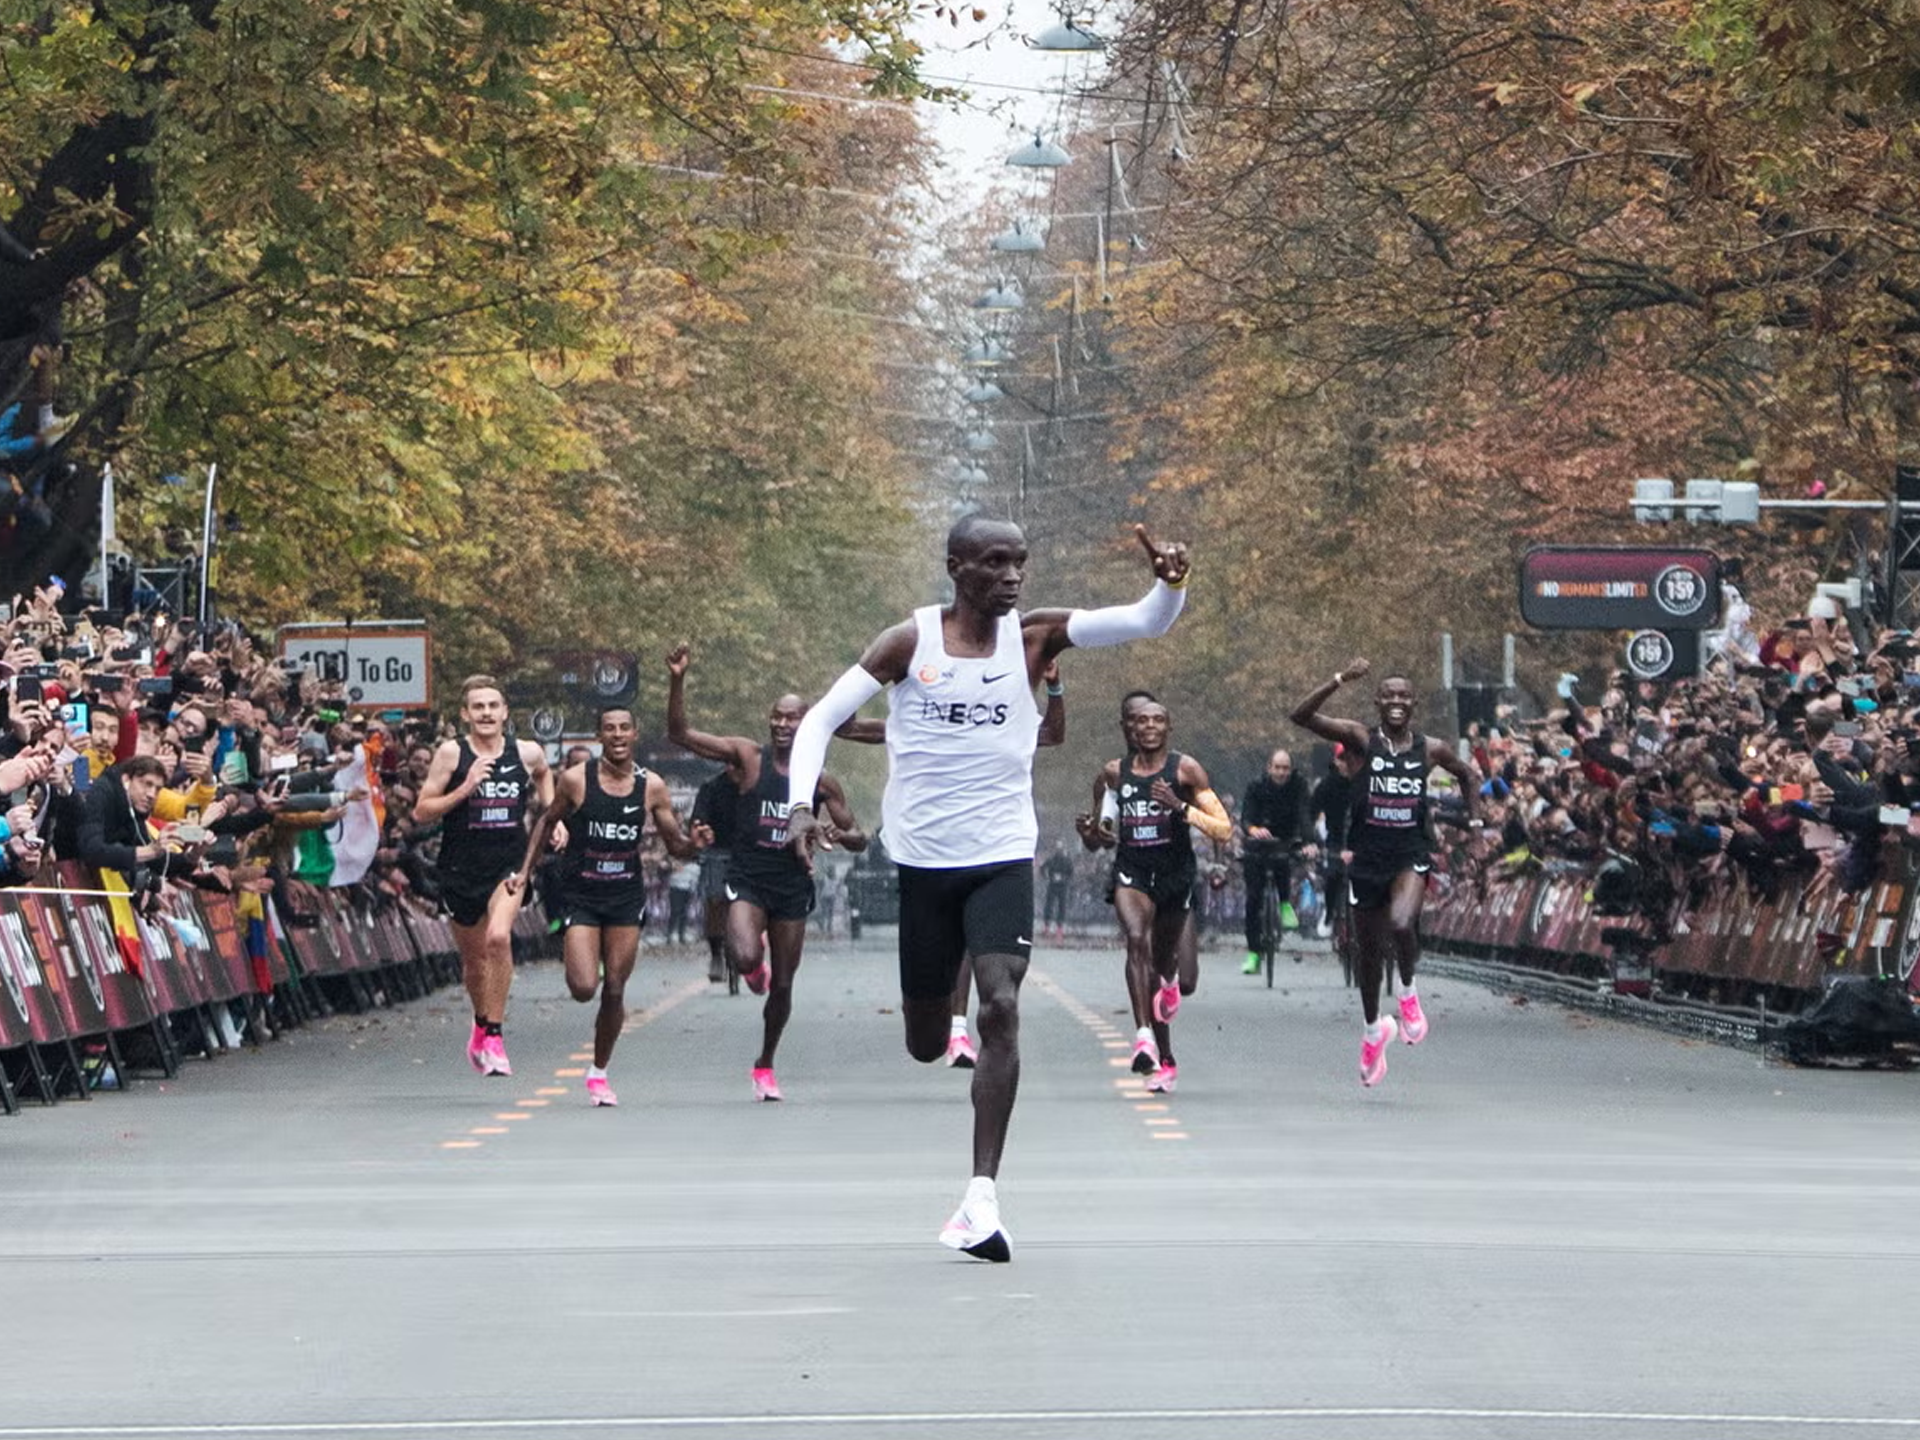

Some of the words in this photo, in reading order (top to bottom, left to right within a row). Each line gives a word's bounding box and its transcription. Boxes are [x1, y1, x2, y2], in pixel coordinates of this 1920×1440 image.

[357, 658, 380, 682] To
[385, 657, 412, 682] Go
[923, 699, 1009, 725] INEOS
[475, 781, 520, 798] NEOS
[1370, 776, 1422, 795] INEOS
[761, 800, 788, 819] INE
[589, 821, 639, 840] INEOS
